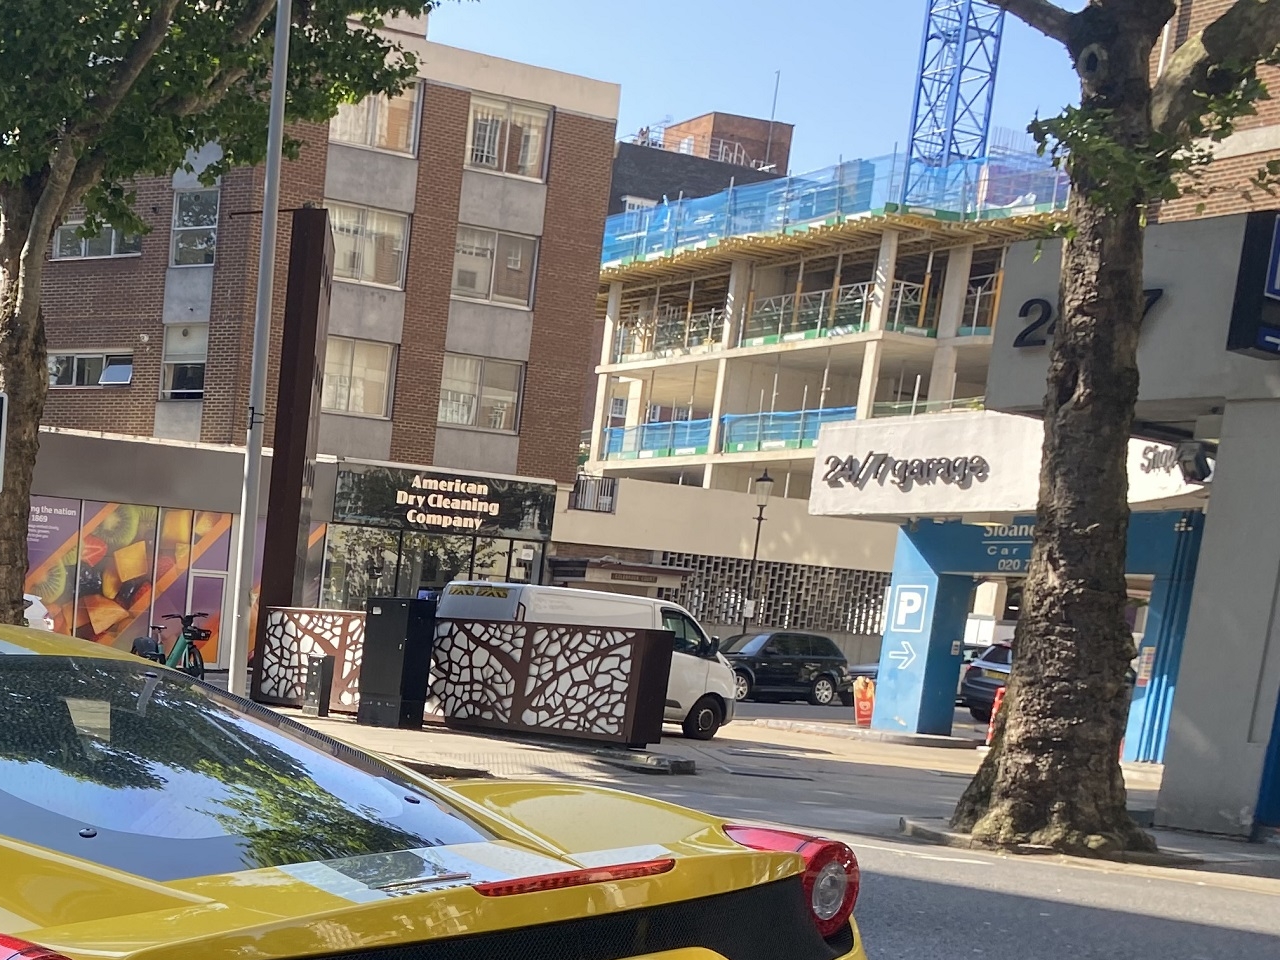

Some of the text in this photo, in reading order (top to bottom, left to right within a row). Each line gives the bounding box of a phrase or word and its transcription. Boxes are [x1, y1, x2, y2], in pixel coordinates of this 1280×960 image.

[411, 475, 489, 496] American
[41, 506, 53, 514] the
[53, 507, 77, 516] nation
[396, 490, 500, 516] Dry Cleaning
[406, 509, 483, 531] Company
[987, 546, 1019, 556] Car
[997, 559, 1021, 571] 020
